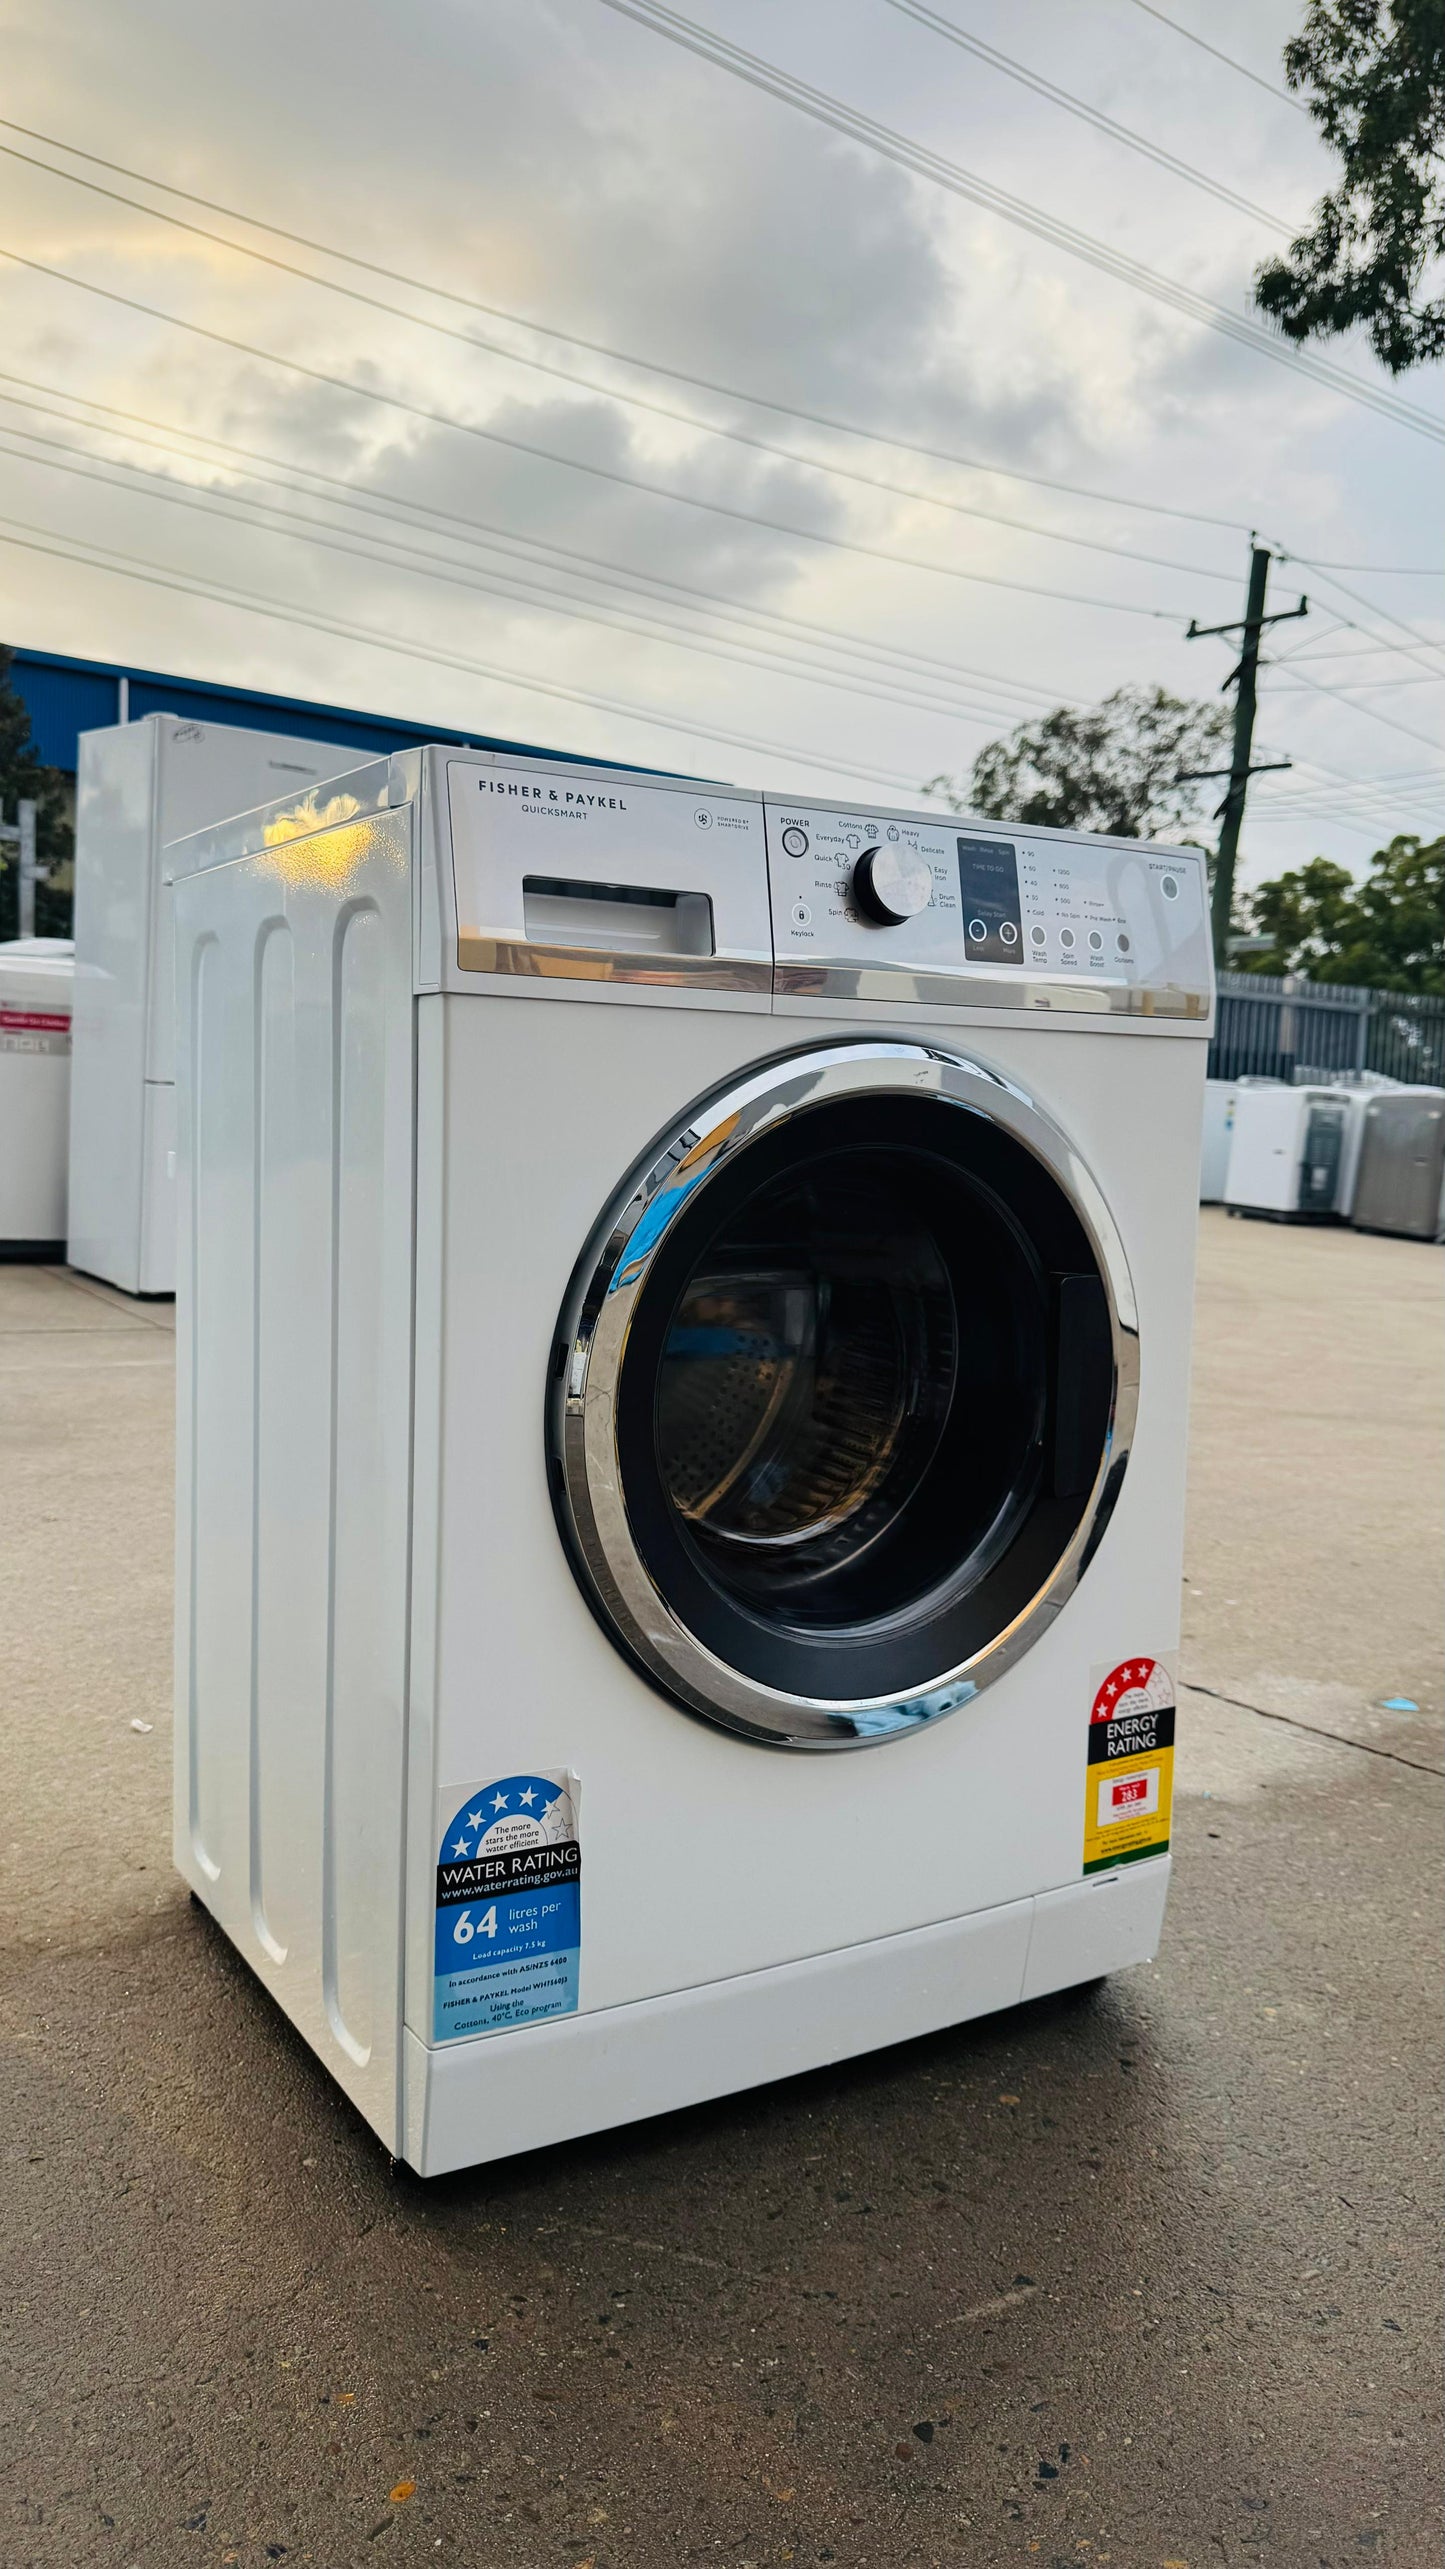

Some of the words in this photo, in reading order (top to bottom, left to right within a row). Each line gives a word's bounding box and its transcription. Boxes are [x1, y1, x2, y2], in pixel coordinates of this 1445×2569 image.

[479, 780, 541, 798] FISHER
[549, 791, 558, 801] &
[566, 793, 627, 810] PAYKEL
[522, 805, 588, 820] QUICKSMART
[781, 818, 809, 827] POWER
[839, 821, 863, 830] Cottons
[816, 834, 844, 843] Everyday
[902, 830, 919, 838] Heavy
[921, 846, 944, 855] Delicate
[1107, 1714, 1158, 1739] ENERGY
[1108, 1732, 1157, 1756] RATING
[495, 1827, 509, 1835] The
[511, 1824, 531, 1832] more
[485, 1837, 504, 1845] stars
[506, 1834, 518, 1842] the
[520, 1830, 539, 1839] more
[486, 1845, 506, 1853] water
[510, 1839, 538, 1850] efficient
[442, 1861, 506, 1885] WATER
[512, 1848, 577, 1874] RATING
[442, 1868, 578, 1900] www.waterrating.gov.au
[510, 1907, 538, 1920] litres
[542, 1902, 561, 1917] per
[453, 1906, 498, 1944] 64
[509, 1919, 537, 1934] wash
[473, 1951, 491, 1960] Load
[493, 1945, 522, 1957] capacity
[458, 1972, 500, 1986] accordance
[520, 1962, 548, 1973] AS/NZS
[443, 1998, 470, 2009] FISHER
[480, 1990, 509, 2001] PAYKEL
[511, 1985, 531, 1995] Model
[490, 2002, 511, 2012] Using
[512, 1999, 524, 2008] the
[454, 2019, 489, 2030] Cottons,
[516, 2008, 529, 2016] Eco
[531, 2001, 561, 2015] program
